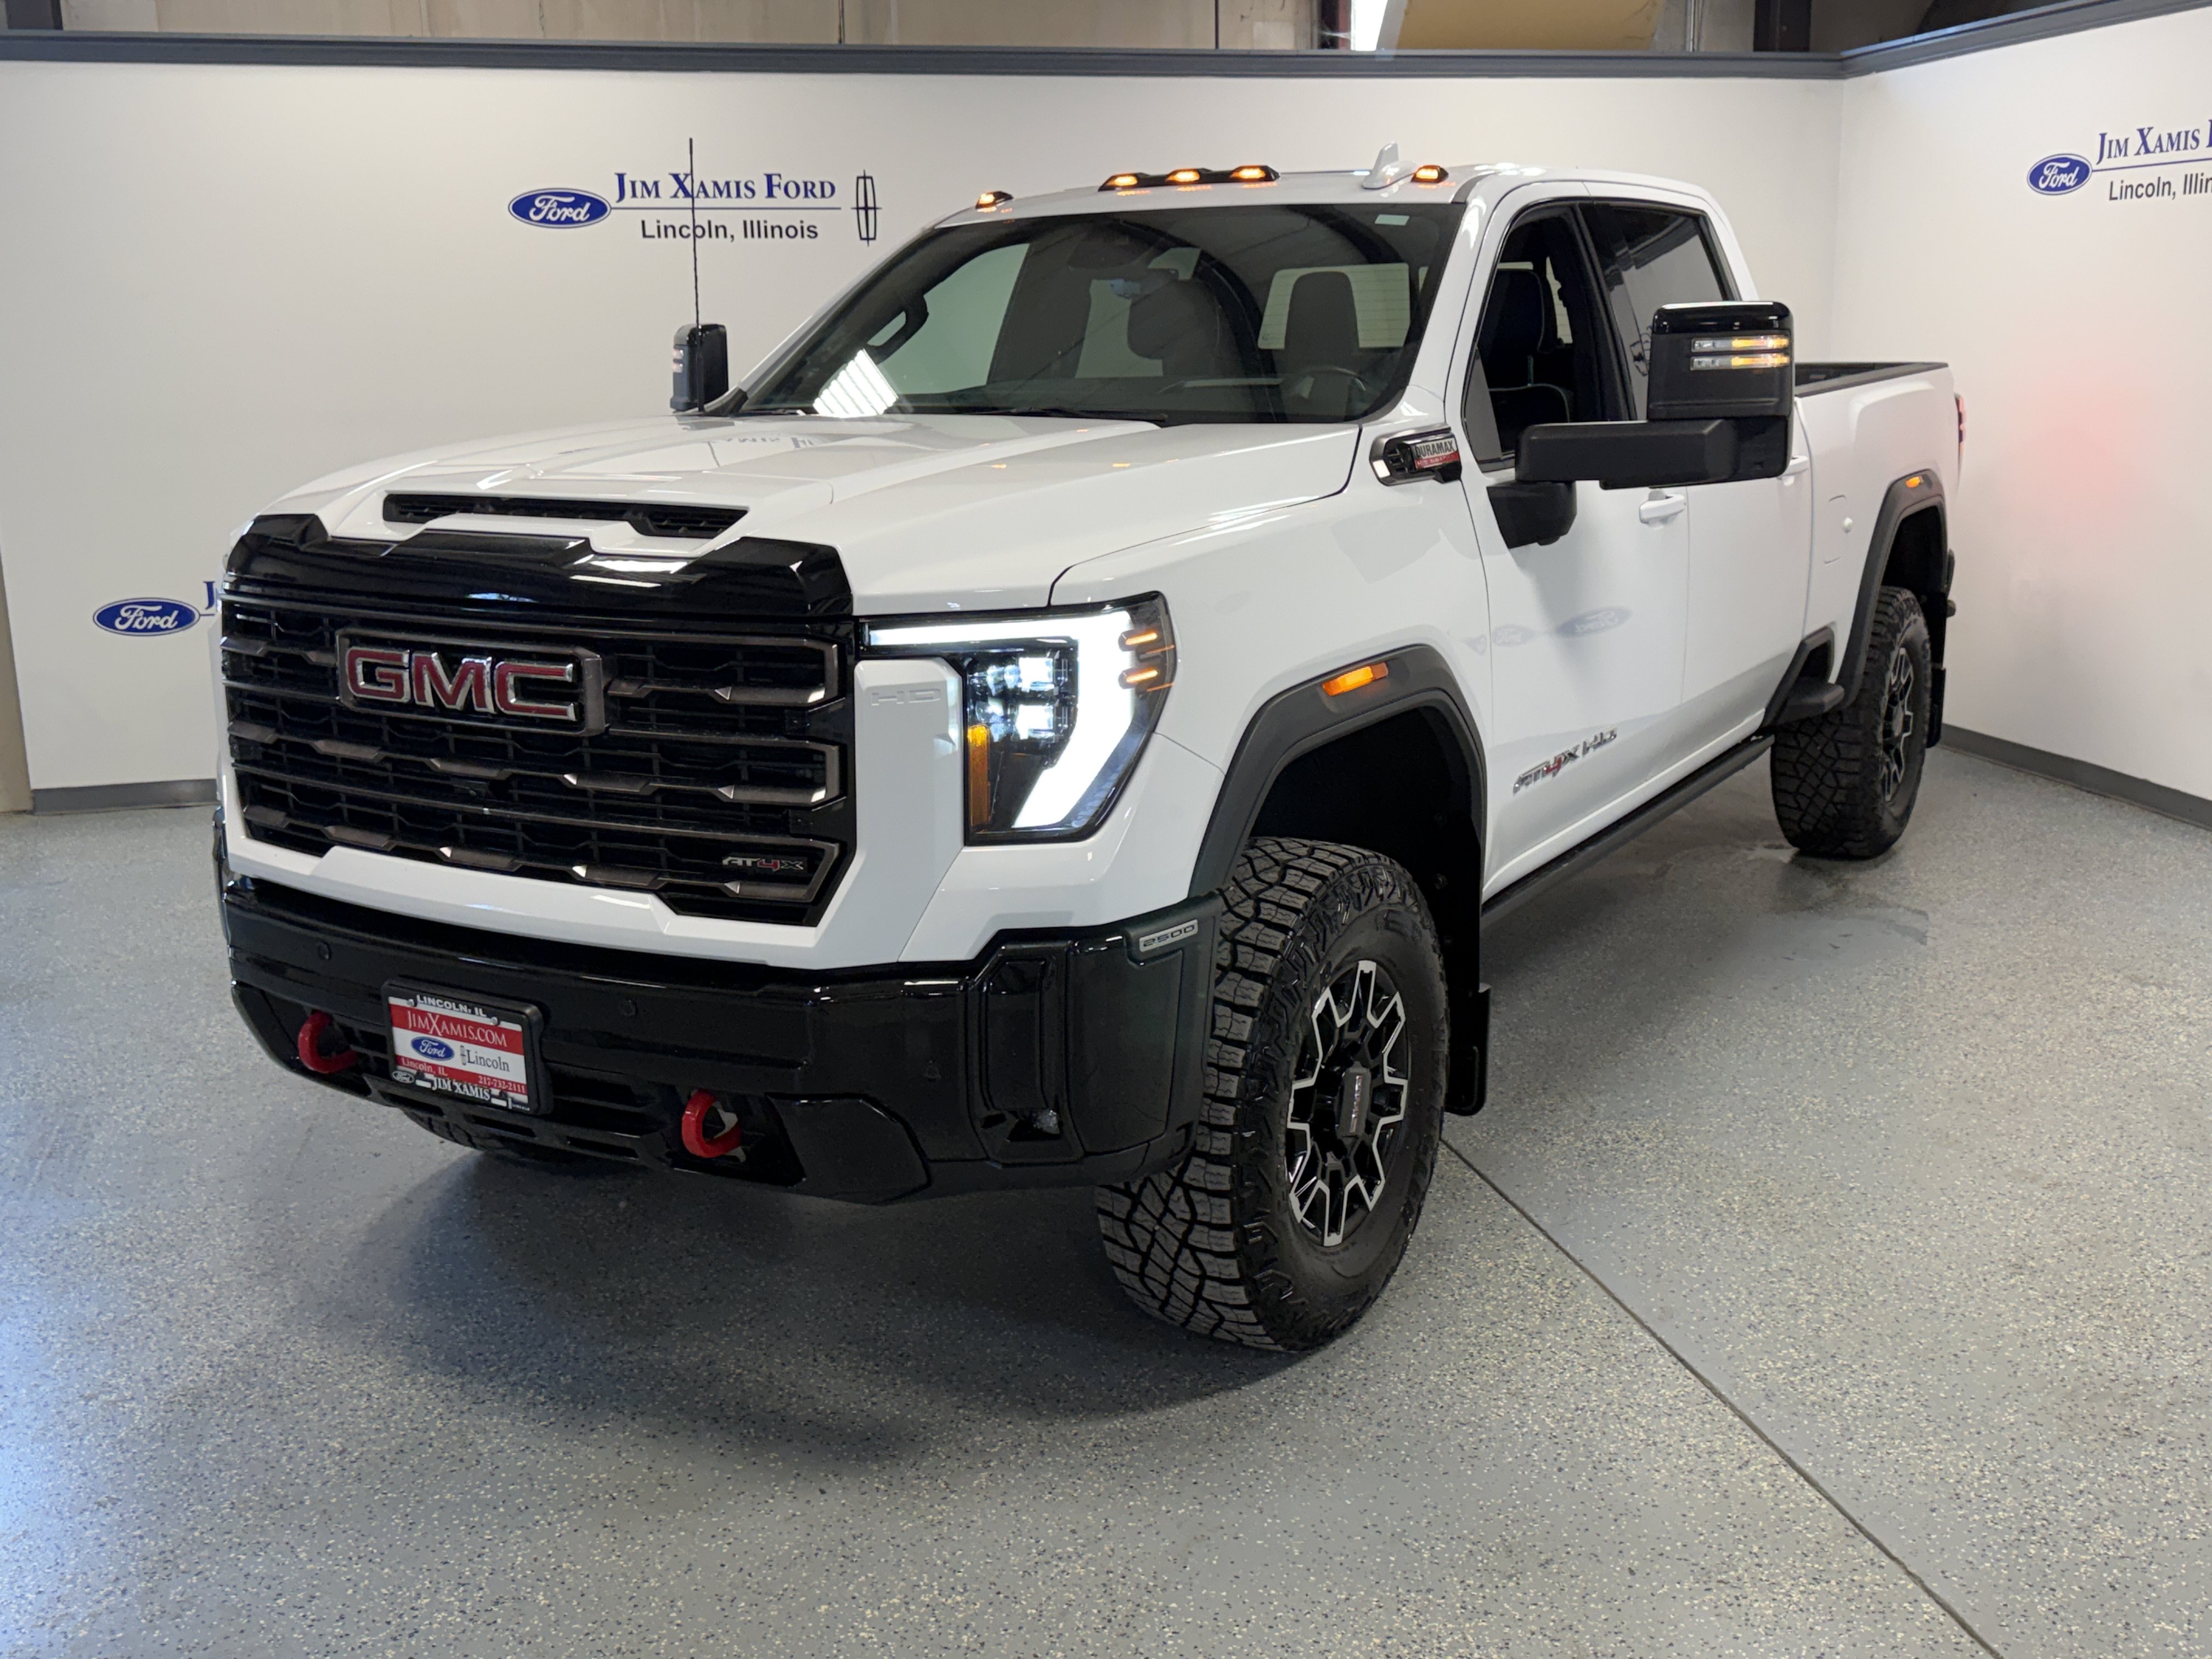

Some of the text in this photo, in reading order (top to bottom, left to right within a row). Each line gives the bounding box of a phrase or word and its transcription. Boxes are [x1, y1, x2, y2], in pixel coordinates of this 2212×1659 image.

[2096, 132, 2130, 165] JIM
[2134, 127, 2200, 155] XAMIS
[2039, 162, 2079, 189] Ford
[614, 173, 836, 203] JIM XAMIS FORD
[2109, 176, 2176, 201] Lincoln,
[529, 195, 590, 221] Ford
[641, 220, 818, 242] Lincoln, Illinois
[1414, 440, 1455, 458] DURAMAX
[115, 605, 178, 630] Ford
[347, 646, 578, 721] GMC
[723, 856, 804, 872] AT4X
[1143, 924, 1195, 947] 2500
[416, 994, 487, 1018] LINCOLN, IL
[408, 1011, 507, 1047] JIMXAMIS.COM
[420, 1040, 445, 1058] Ford
[467, 1049, 510, 1071] Lincoln
[438, 1065, 448, 1076] IL
[431, 1077, 490, 1101] JIM XAMIS
[478, 1075, 526, 1093] 217-732-2111
